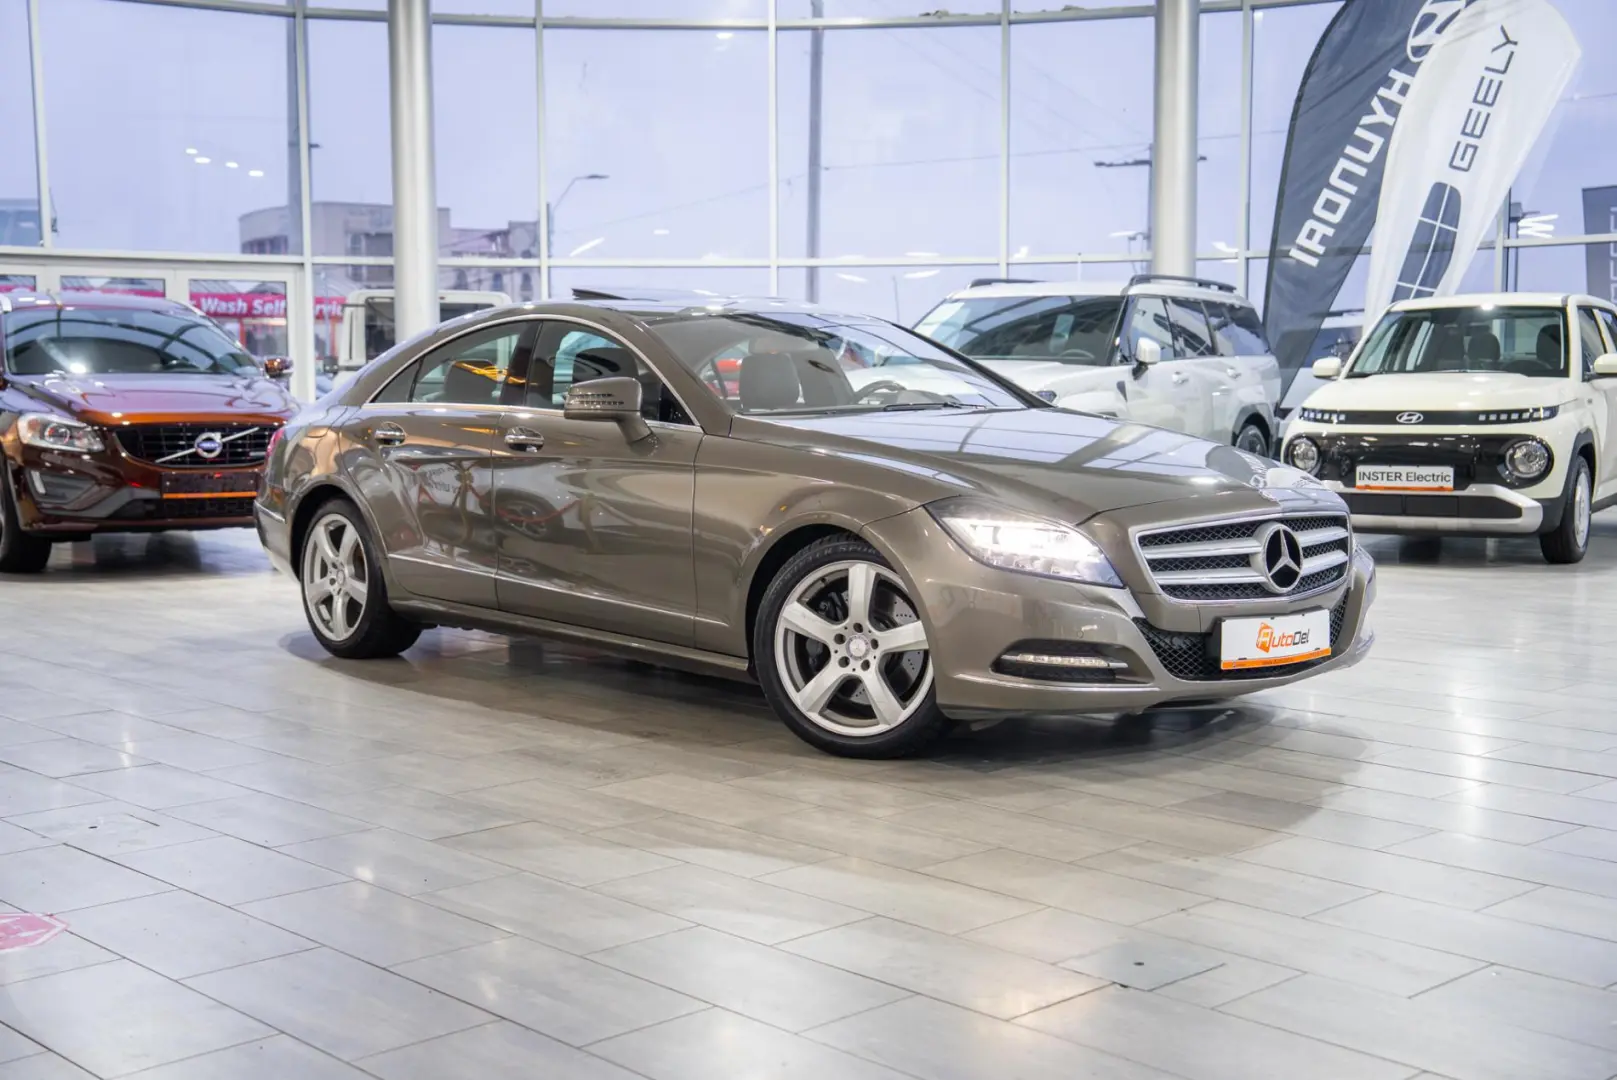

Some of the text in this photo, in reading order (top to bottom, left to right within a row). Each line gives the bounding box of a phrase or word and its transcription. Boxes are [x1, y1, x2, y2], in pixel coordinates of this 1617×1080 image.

[1448, 24, 1518, 172] GEELY
[199, 296, 248, 314] Wash
[252, 298, 286, 315] Self
[1358, 471, 1451, 483] INSTER Electric
[1256, 622, 1310, 653] AutoDel
